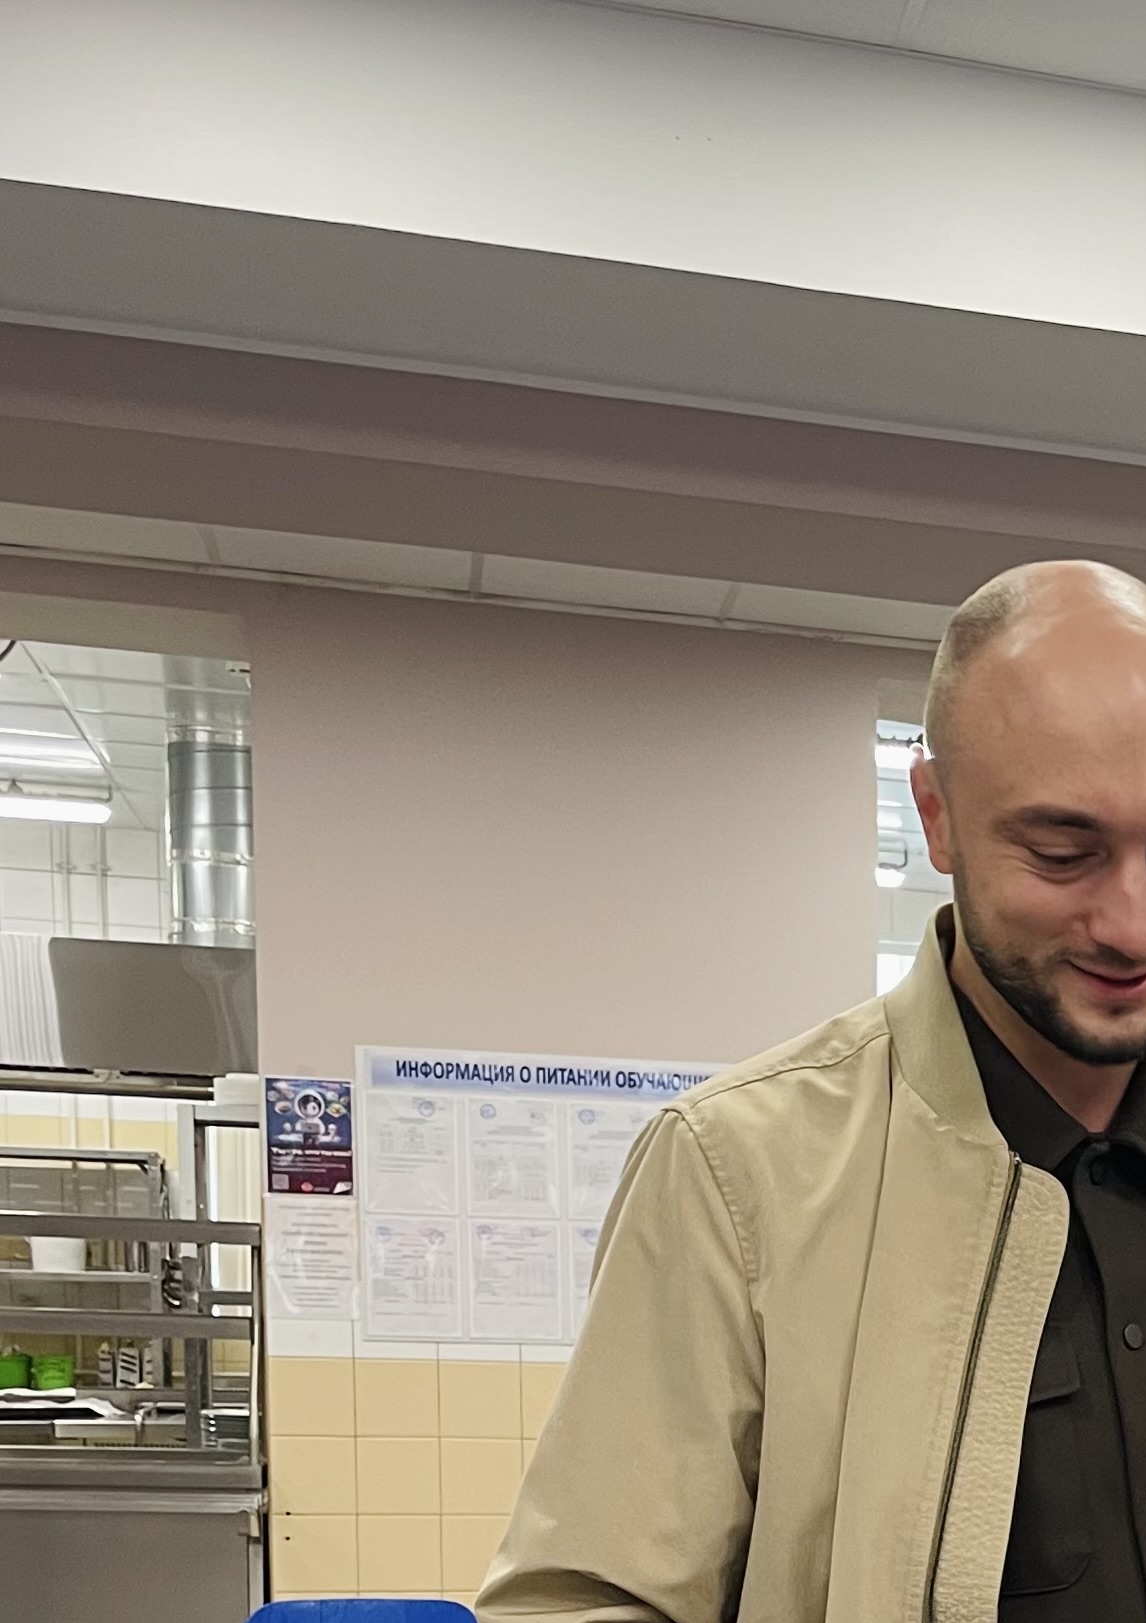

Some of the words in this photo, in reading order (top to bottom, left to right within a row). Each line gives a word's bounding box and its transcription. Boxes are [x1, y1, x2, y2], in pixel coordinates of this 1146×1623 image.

[396, 1060, 515, 1085] ИНФОРМАЦИЯ
[520, 1065, 532, 1084] О
[536, 1066, 611, 1087] ПИТАНИИ
